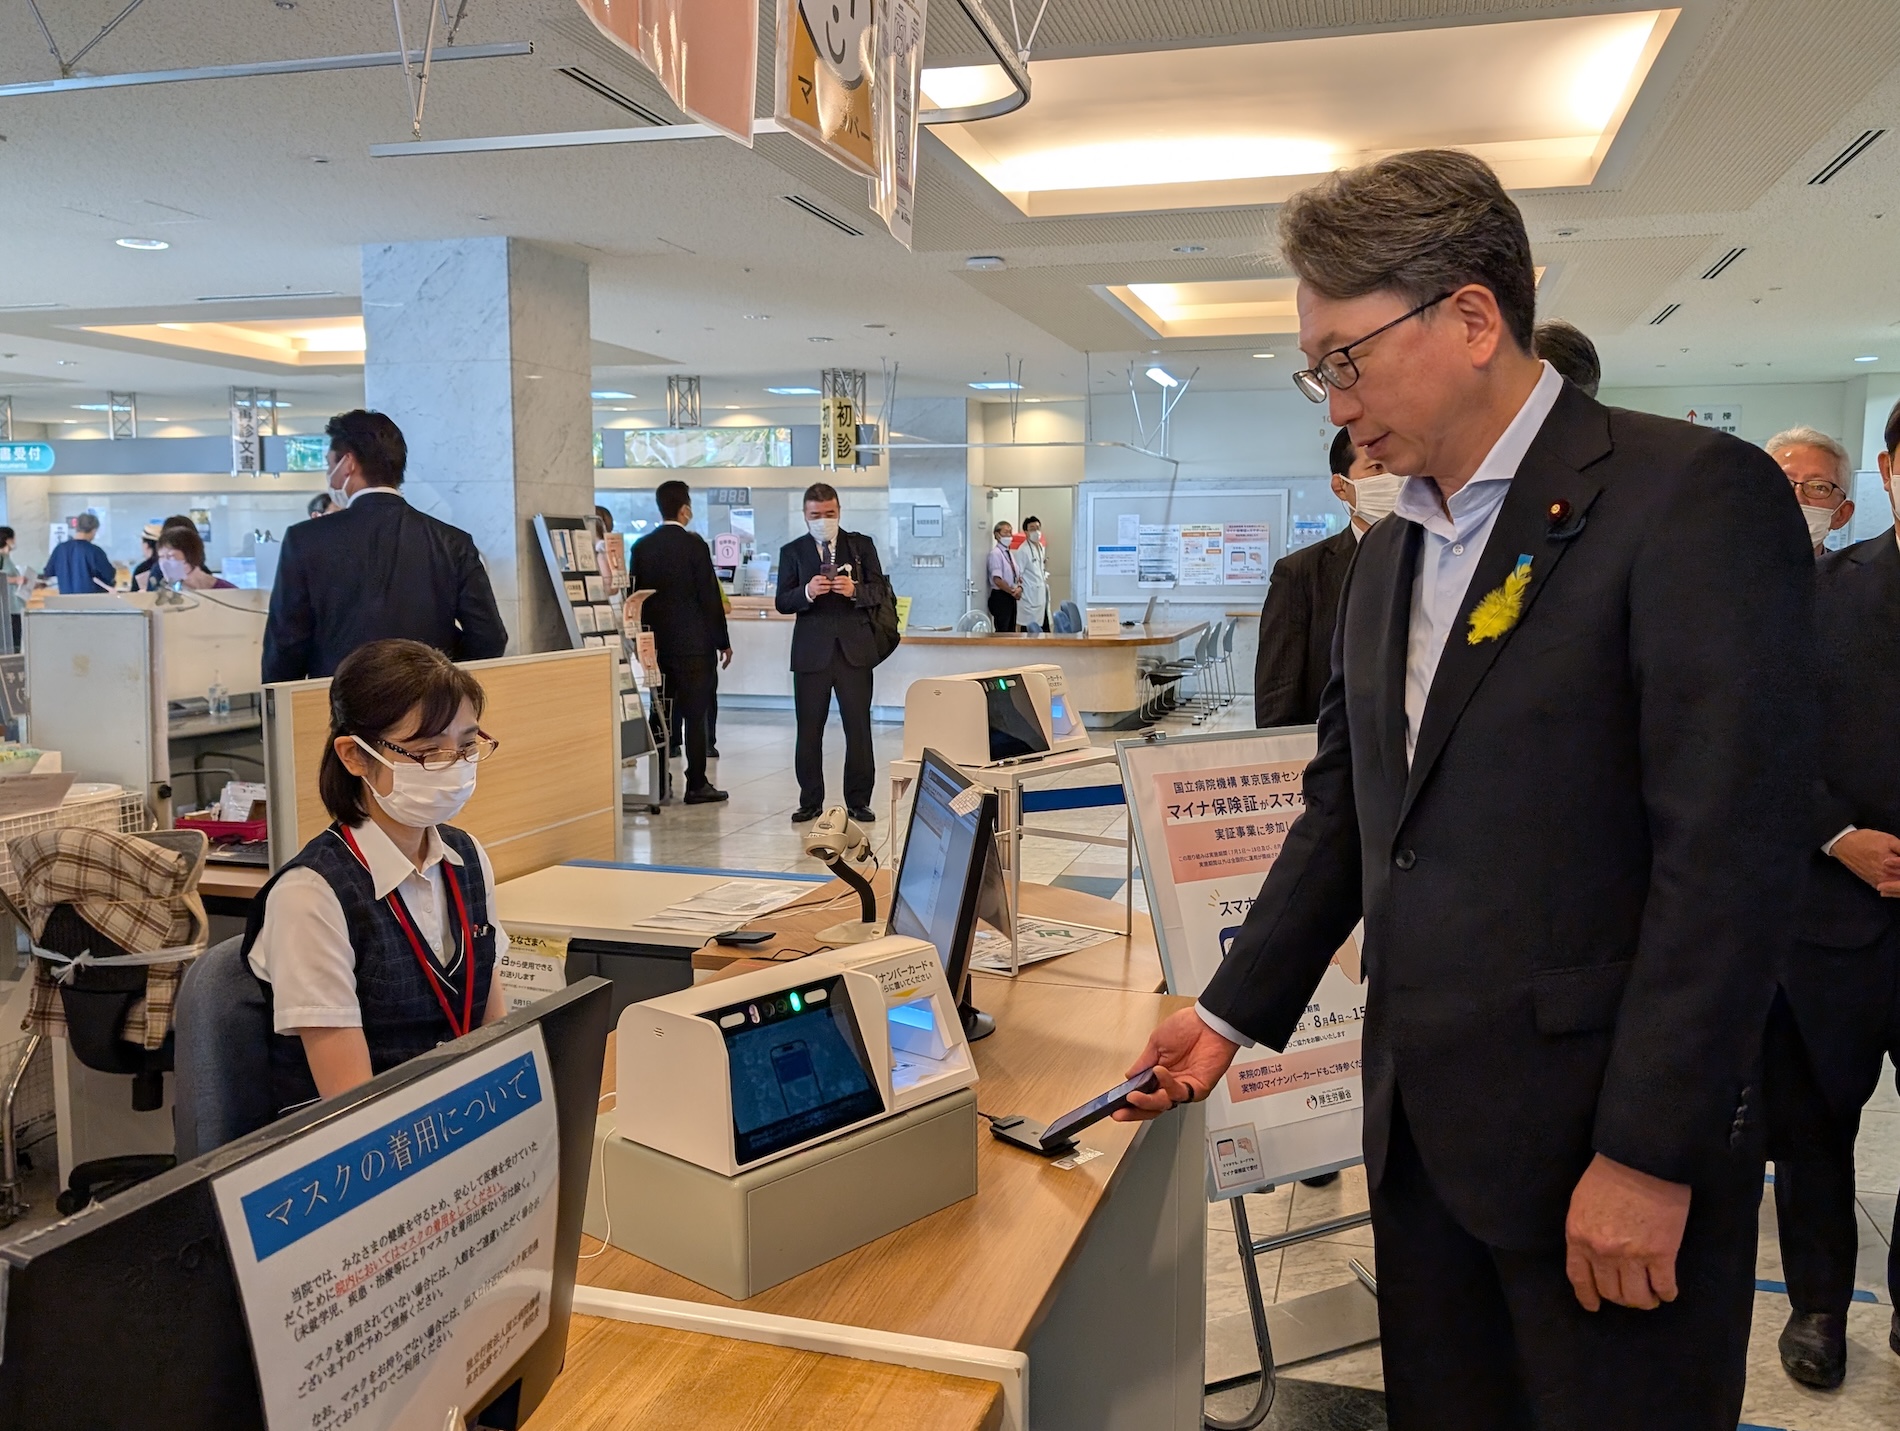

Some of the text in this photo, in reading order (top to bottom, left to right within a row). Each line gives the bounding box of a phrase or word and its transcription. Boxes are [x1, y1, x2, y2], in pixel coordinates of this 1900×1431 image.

[836, 401, 853, 459] 初診
[1173, 777, 1238, 794] 国立病院機構
[1214, 821, 1289, 841] 実証事業に参加し
[509, 935, 547, 948] みなさまへ
[883, 972, 933, 993] らに置いてください
[1285, 1031, 1346, 1049] ひご協力をお願いいたします
[1238, 1064, 1283, 1081] 来院の際には
[265, 1070, 529, 1226] マスクの着用について
